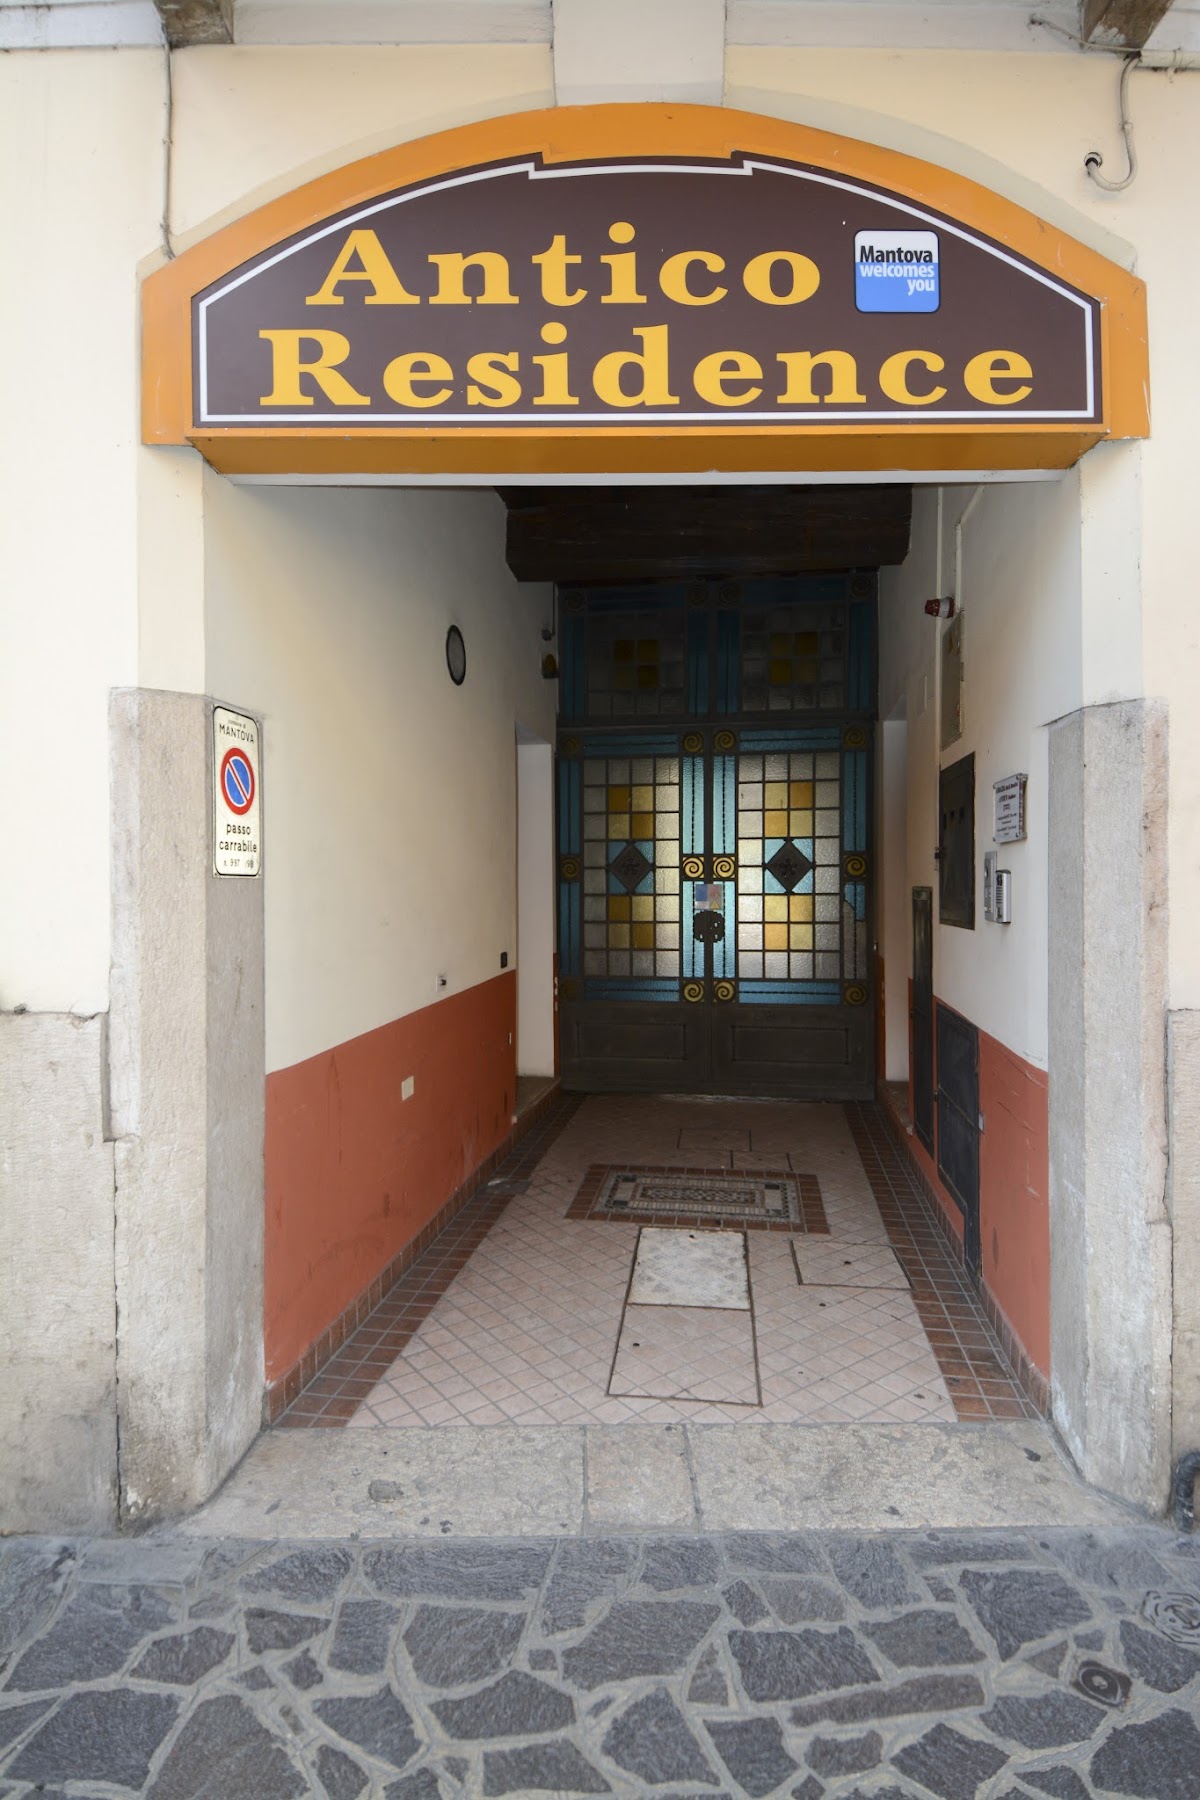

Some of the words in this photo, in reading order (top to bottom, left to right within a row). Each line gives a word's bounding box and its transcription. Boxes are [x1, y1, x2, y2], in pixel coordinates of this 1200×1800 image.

[860, 245, 933, 263] Mantova
[304, 221, 821, 307] Antico
[859, 263, 935, 278] welcomes
[906, 279, 935, 296] you
[258, 322, 1034, 408] Residence
[219, 723, 255, 744] MANTOVA
[226, 823, 252, 836] passo
[219, 840, 257, 853] carrabile
